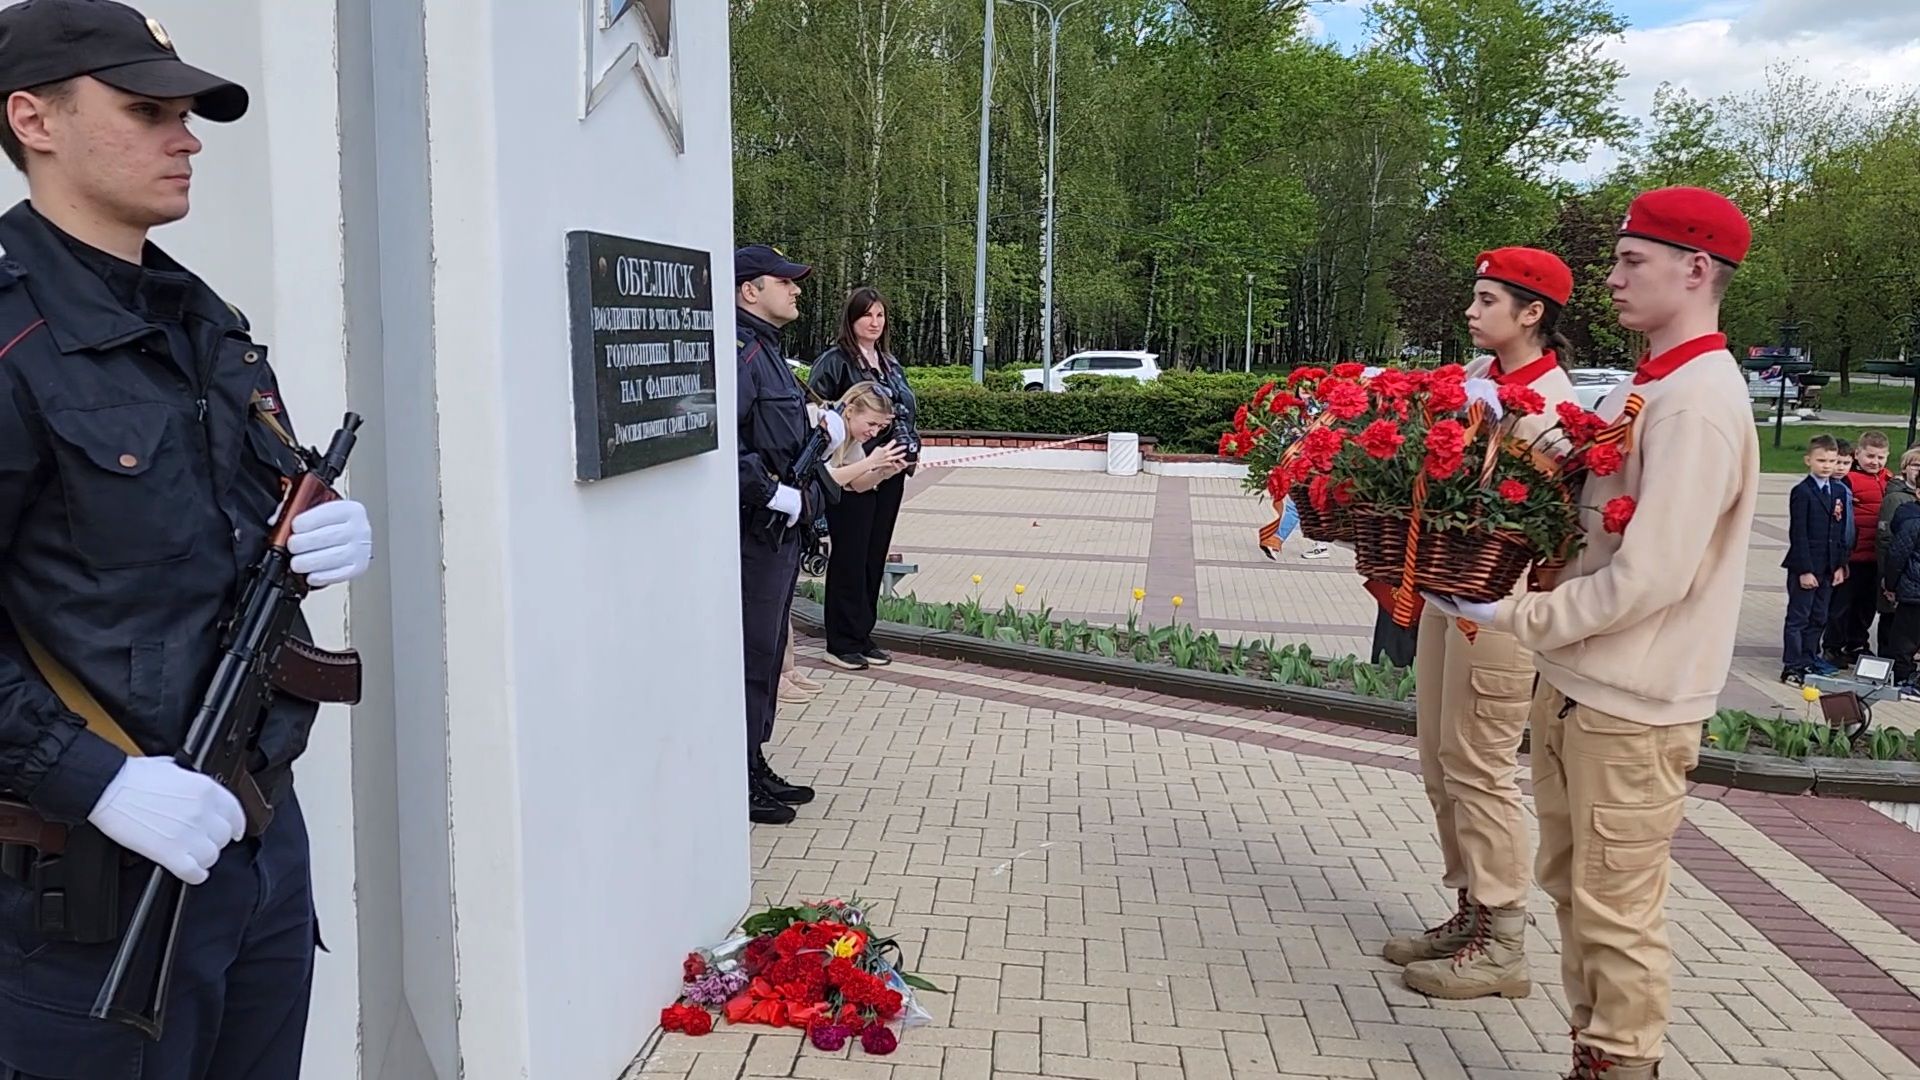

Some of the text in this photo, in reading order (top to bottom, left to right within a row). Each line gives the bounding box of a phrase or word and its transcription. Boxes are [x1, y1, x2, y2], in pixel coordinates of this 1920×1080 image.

[616, 255, 695, 299] ОБЕЛИСК
[593, 307, 647, 334] ВОЗДВИГНУТ
[649, 308, 656, 330] В
[655, 308, 680, 330] ЧЕСТЬ
[681, 307, 691, 330] 25
[605, 343, 670, 371] ГОДОВЩИНЫ
[620, 374, 701, 406] НАД ФАШИЗМОМ
